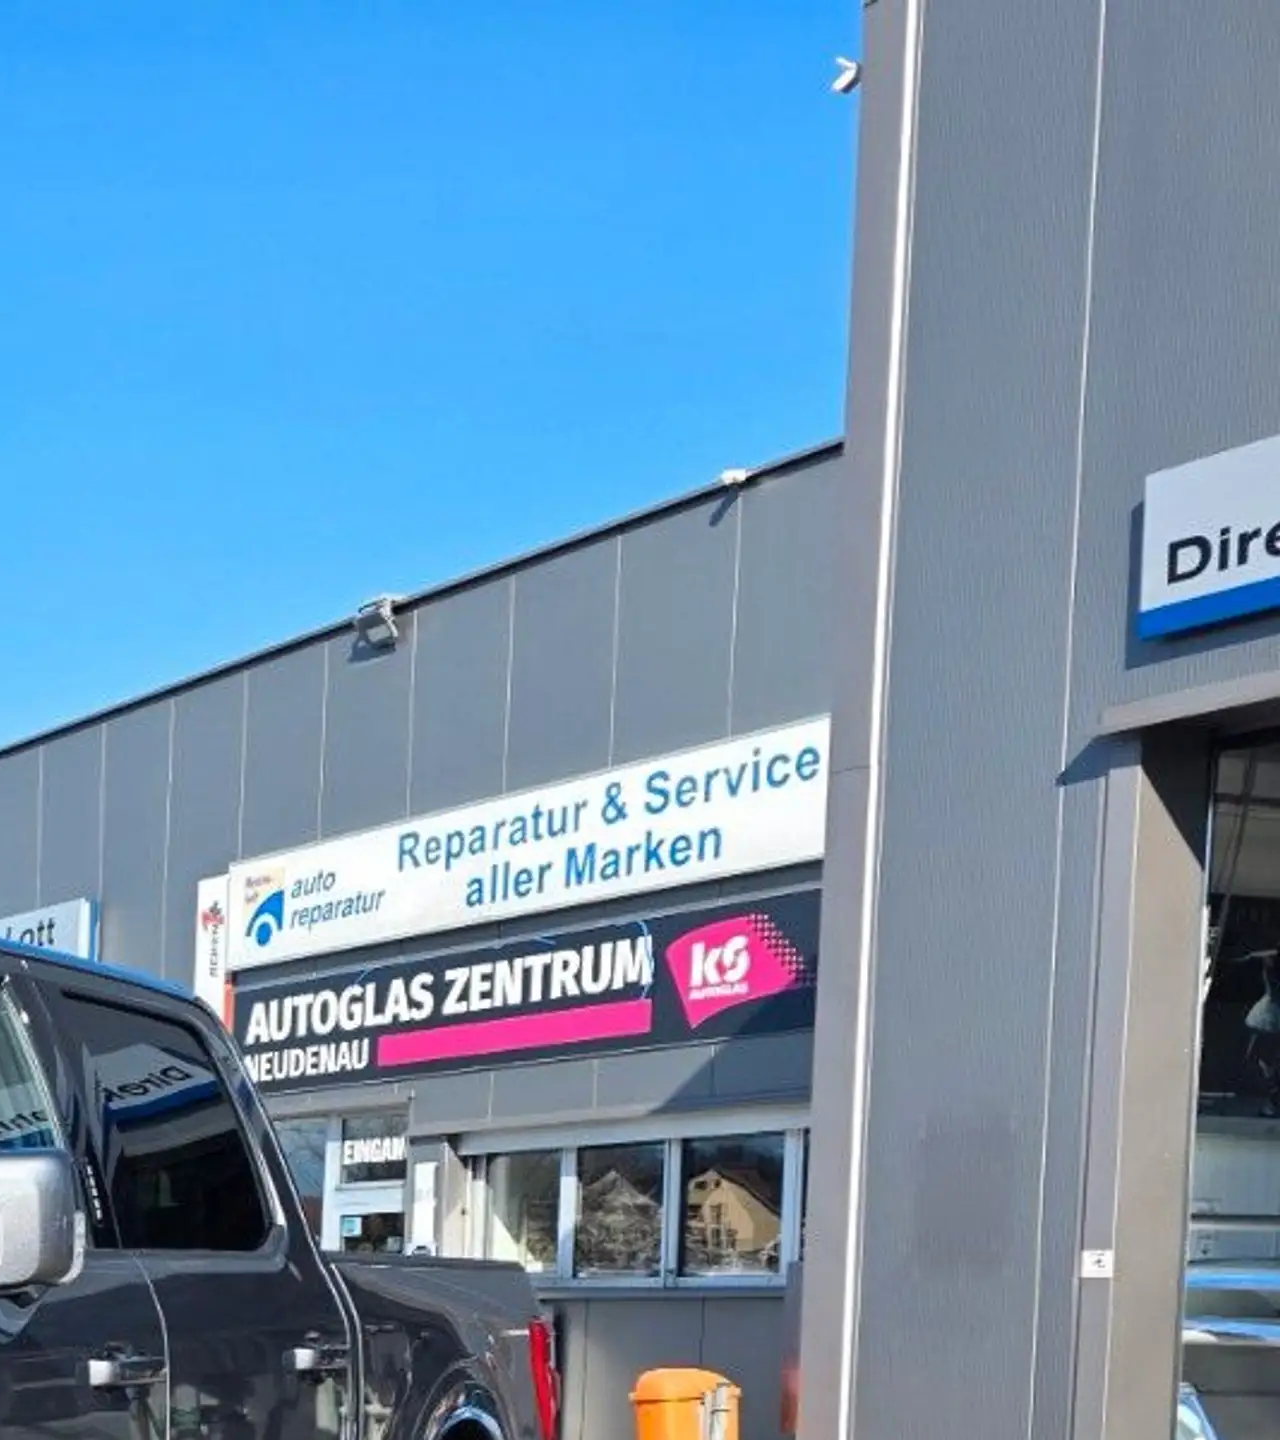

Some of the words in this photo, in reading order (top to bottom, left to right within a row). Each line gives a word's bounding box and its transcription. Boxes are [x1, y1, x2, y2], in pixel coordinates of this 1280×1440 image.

[398, 797, 588, 872] Reparatur
[601, 781, 629, 826] &
[644, 745, 821, 816] Service
[290, 869, 337, 900] auto
[465, 858, 553, 908] aller
[564, 826, 722, 889] Marken
[289, 889, 386, 934] reparatur
[244, 972, 436, 1047] AUTOGLAS
[442, 935, 654, 1017] ZENTRUM
[244, 1038, 370, 1083] NEUDENAU
